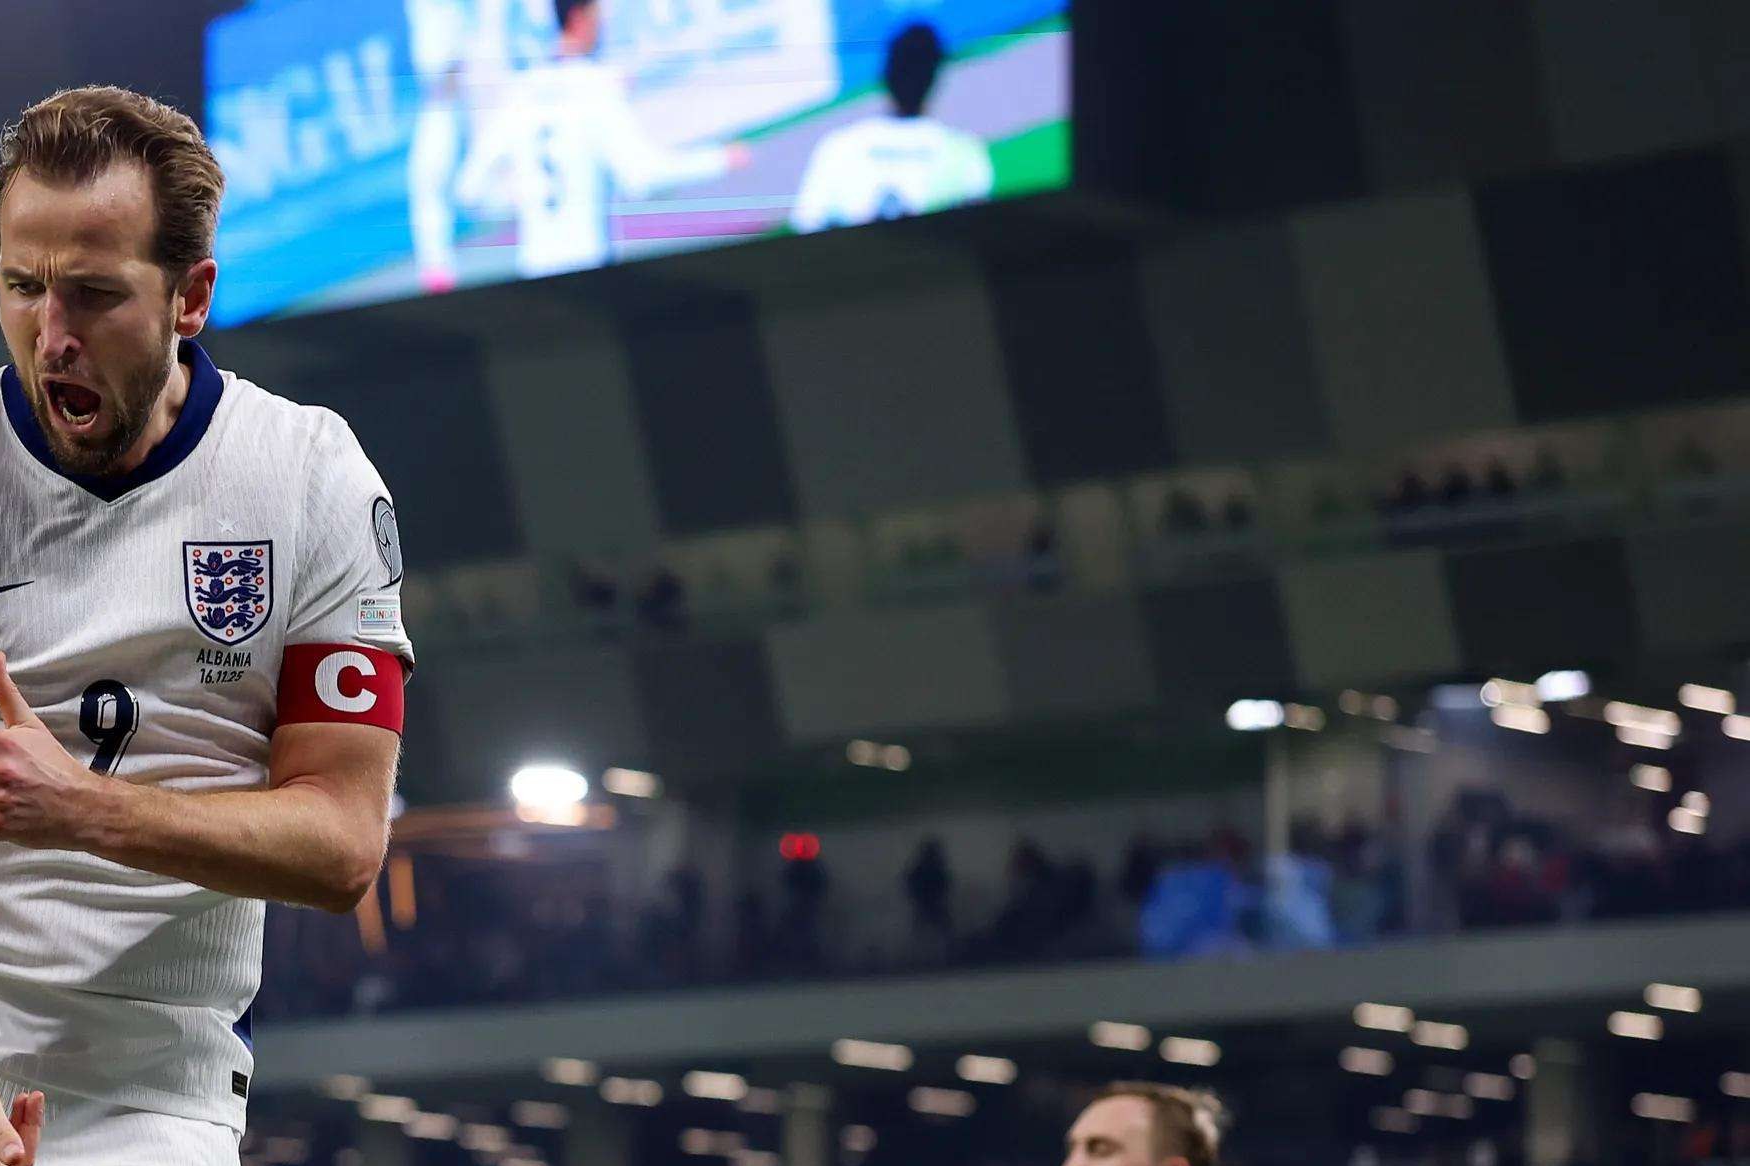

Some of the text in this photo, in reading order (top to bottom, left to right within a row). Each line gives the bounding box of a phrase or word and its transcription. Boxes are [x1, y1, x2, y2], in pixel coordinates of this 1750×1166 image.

[195, 648, 251, 667] ALBANIA
[200, 667, 244, 684] 16.11.25
[314, 650, 377, 713] C
[79, 678, 140, 777] 9
